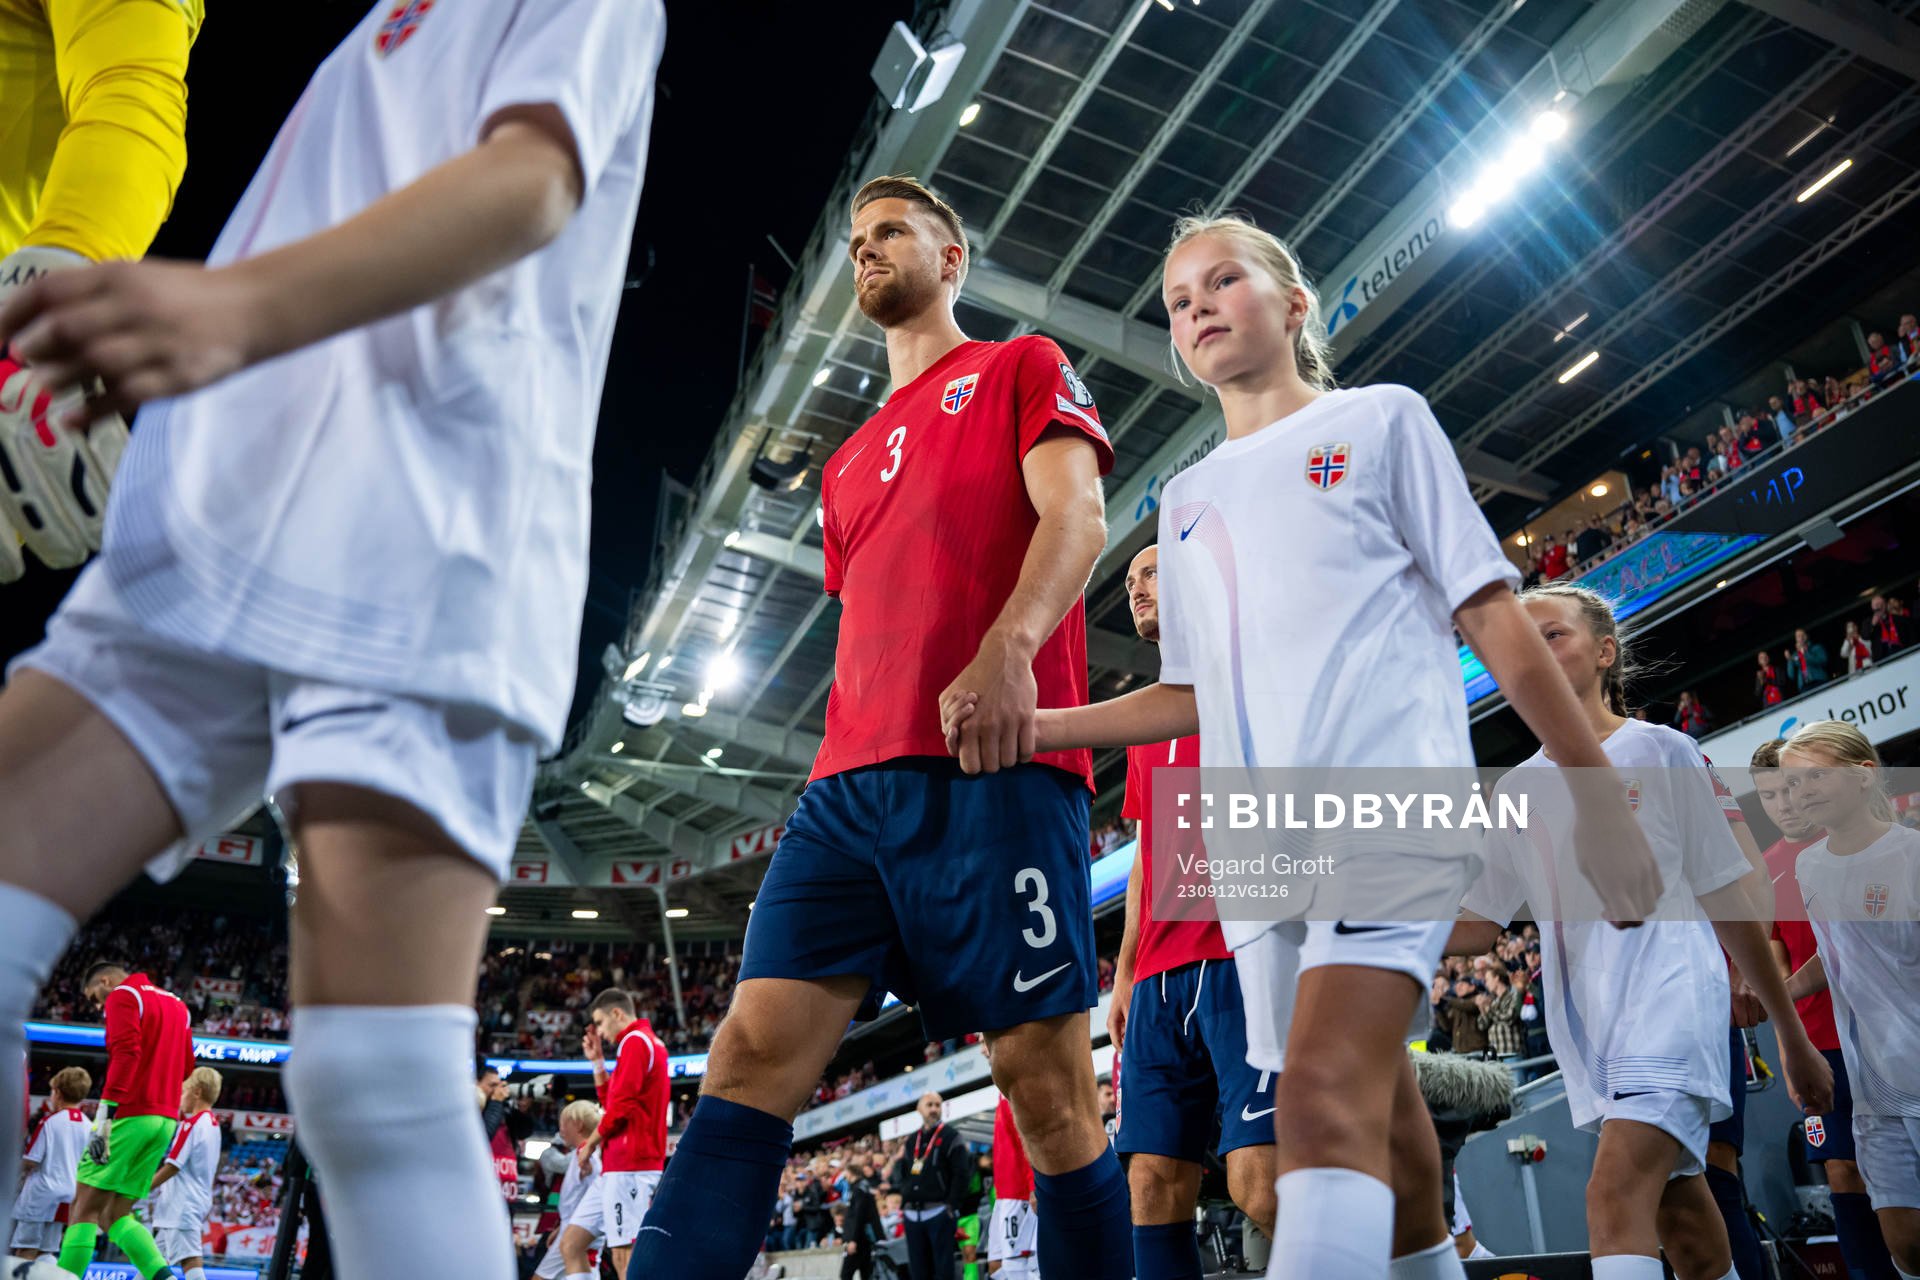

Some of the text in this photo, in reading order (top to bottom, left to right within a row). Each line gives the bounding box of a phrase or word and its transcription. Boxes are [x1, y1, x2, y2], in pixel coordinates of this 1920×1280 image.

[880, 426, 907, 483] 3
[1802, 685, 1908, 728] enor
[1015, 868, 1057, 949] 3
[615, 1203, 623, 1226] 3
[1004, 1215, 1018, 1239] 16
[1813, 1263, 1837, 1275] VAR
